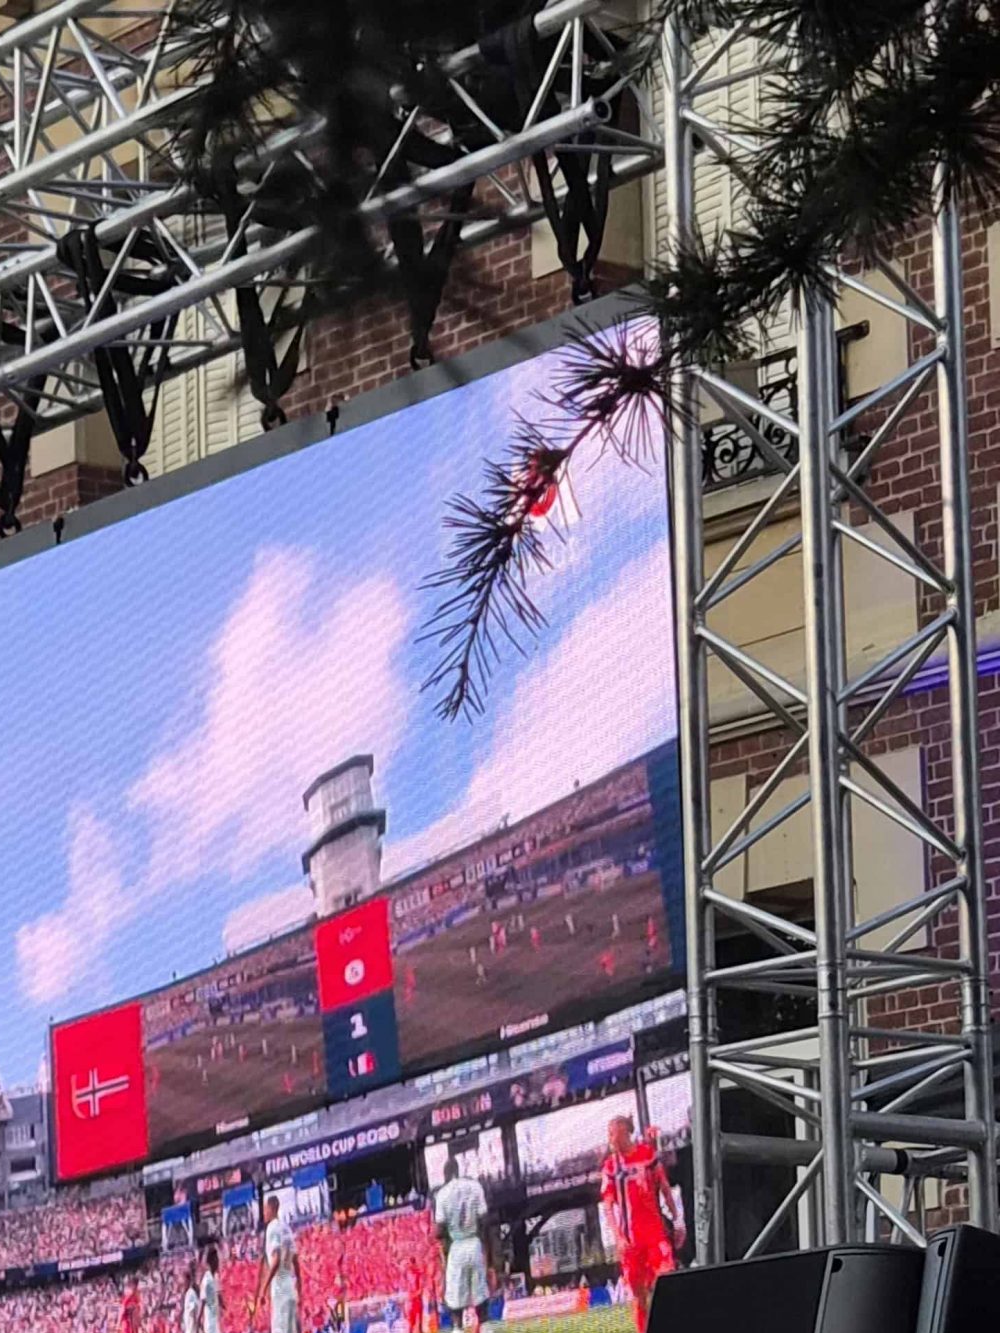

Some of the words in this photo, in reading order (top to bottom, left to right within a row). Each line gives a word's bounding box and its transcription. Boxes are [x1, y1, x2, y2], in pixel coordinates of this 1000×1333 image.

[350, 1012, 368, 1039] 1
[265, 1154, 290, 1176] FIFA
[290, 1143, 332, 1168] WORLD
[332, 1136, 356, 1157] CUP
